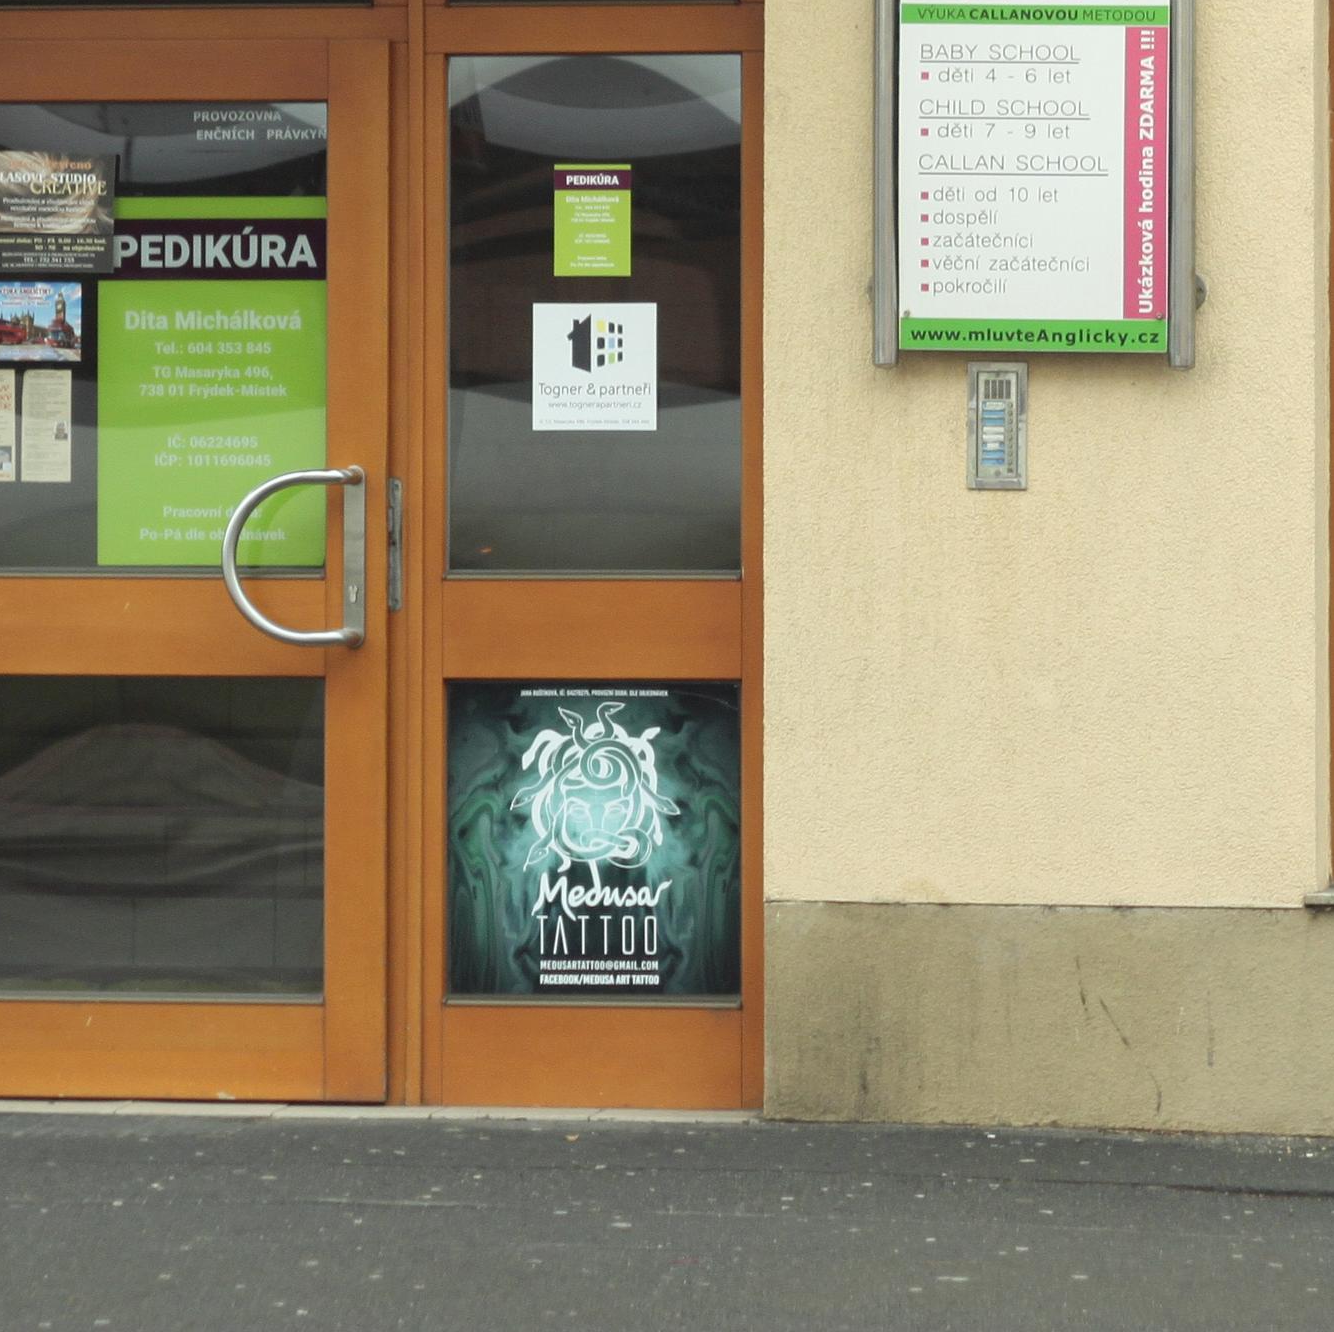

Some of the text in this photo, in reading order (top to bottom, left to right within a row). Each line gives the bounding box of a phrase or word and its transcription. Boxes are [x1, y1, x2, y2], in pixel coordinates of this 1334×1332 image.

[917, 4, 1156, 22] VÝUKA CALLANOVOU METODOU
[920, 44, 1081, 61] BABY SCHOOL
[938, 67, 974, 84] děti
[985, 69, 997, 83] 4
[1025, 68, 1037, 83] 6
[1047, 68, 1071, 84] let
[1139, 56, 1155, 141] ZDARMA
[193, 110, 282, 122] PROVOZOVNA
[919, 99, 1090, 117] CHILD SCHOOL
[937, 123, 974, 140] děti
[984, 124, 996, 139] 7
[1024, 124, 1036, 139] 9
[1047, 123, 1071, 139] let
[918, 154, 1109, 172] CALLAN SCHOOL
[49, 172, 97, 185] STUDIO
[566, 173, 619, 186] PEDIKÚRA
[1138, 145, 1154, 213] hodina
[30, 180, 107, 196] CREATIVE
[933, 187, 1059, 203] děti od 10 let
[933, 209, 999, 228] dospělí
[115, 226, 317, 269] PEDIKÚRA
[933, 232, 1034, 249] začátečníci
[932, 255, 1090, 272] věční začátečníci
[1137, 219, 1154, 314] Ukázková
[933, 278, 1007, 297] pokročilí
[124, 308, 302, 331] Dita Michálková
[910, 327, 1160, 347] www.mluvteAnglicky.cz
[218, 342, 243, 355] 353
[175, 366, 241, 381] Masaryka
[538, 381, 651, 399] Togner & partneři
[163, 505, 222, 518] Pracovní
[531, 864, 673, 921] Medusa
[536, 914, 658, 955] TATTOO
[615, 973, 630, 985] ART
[631, 973, 659, 985] TATTOO
